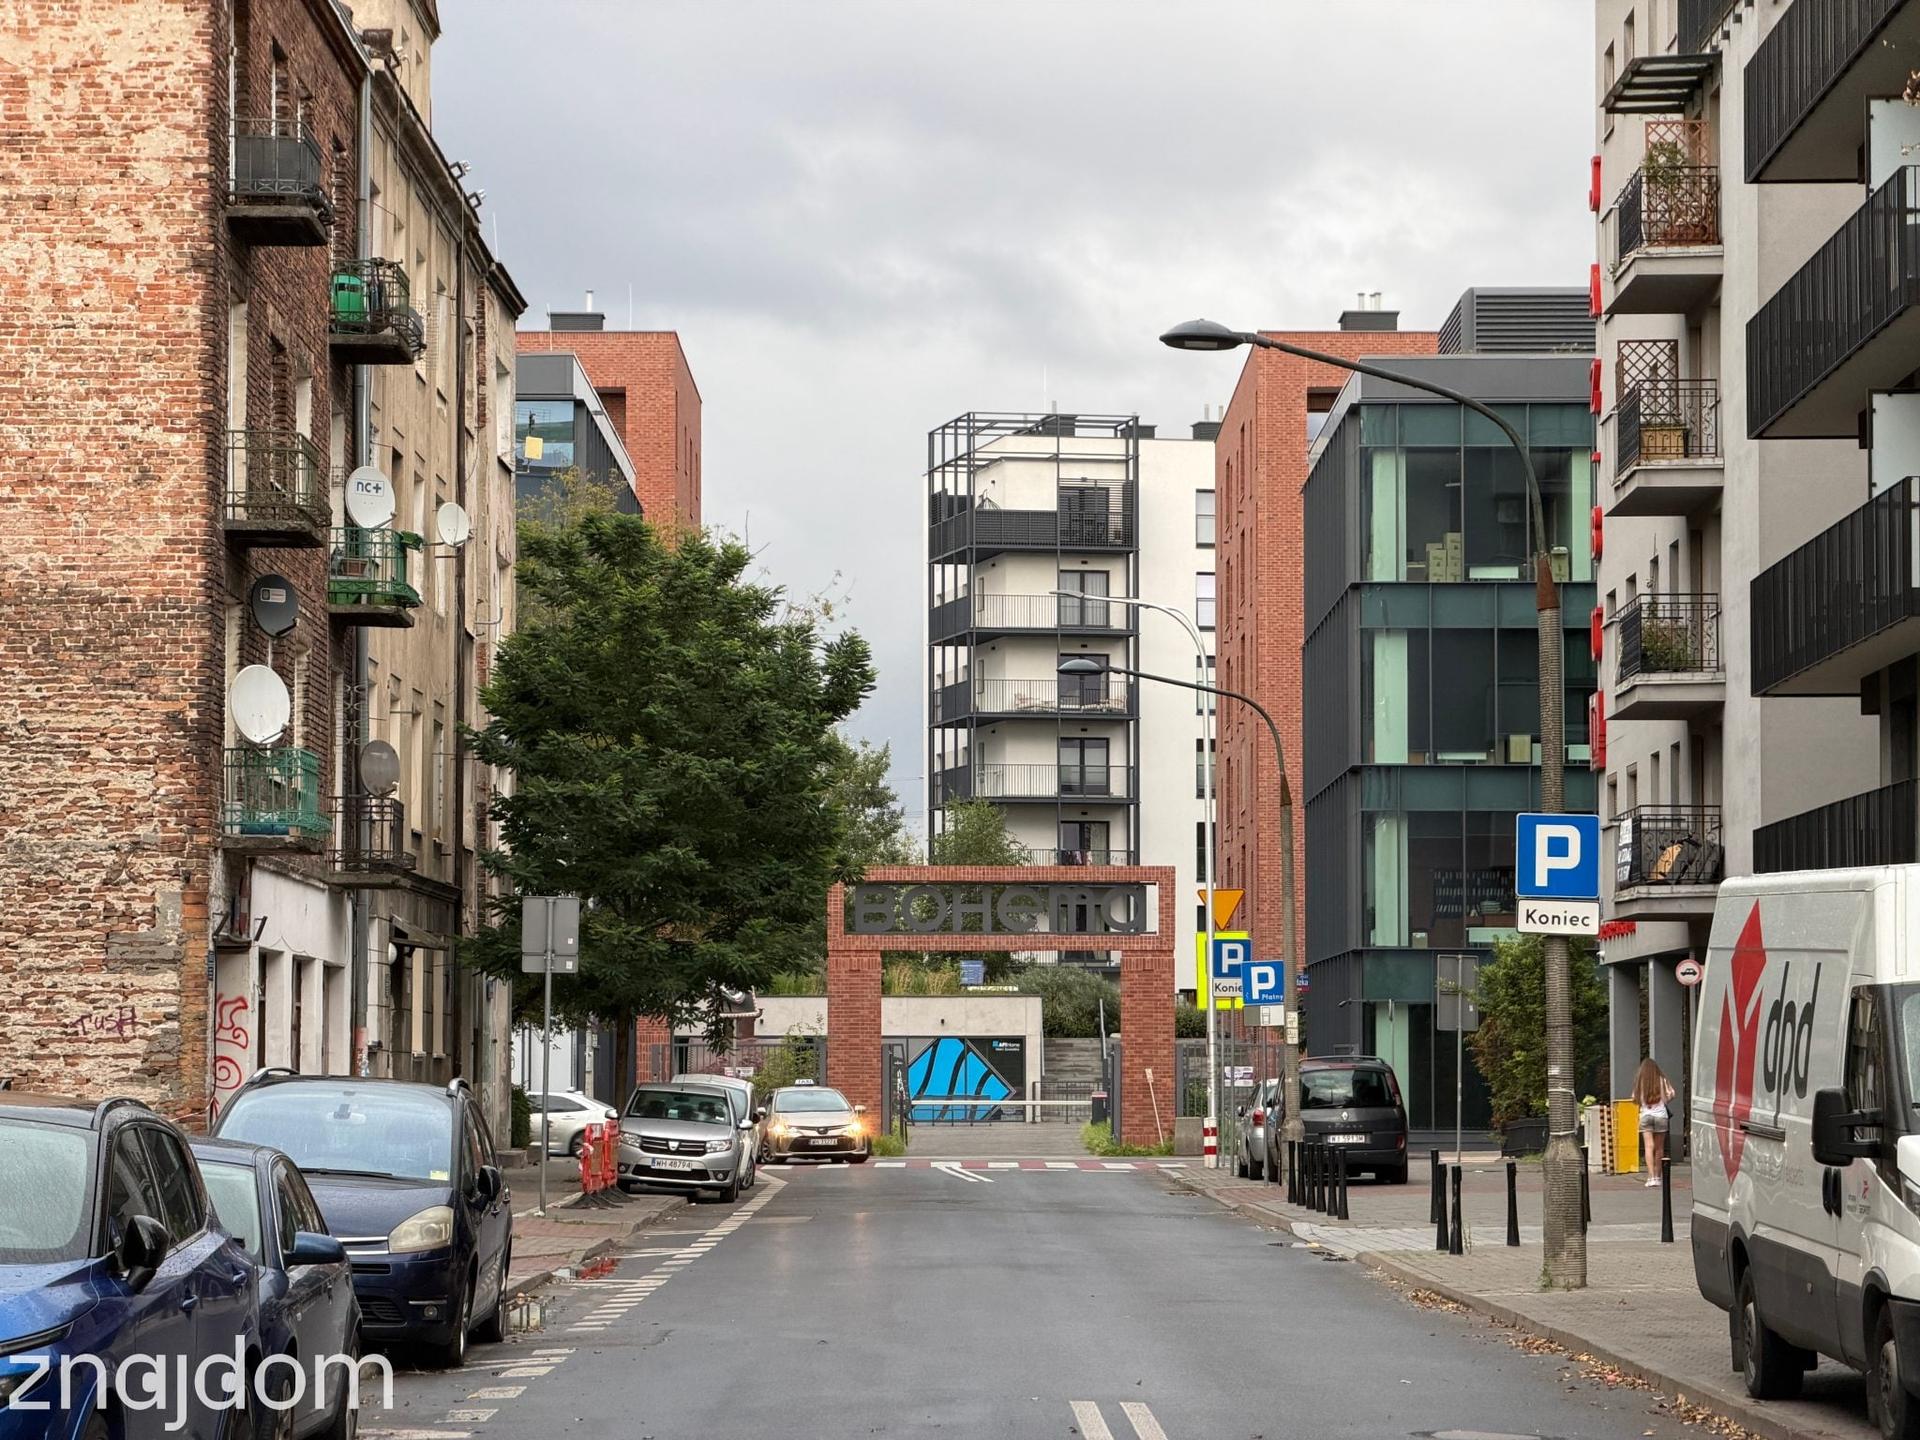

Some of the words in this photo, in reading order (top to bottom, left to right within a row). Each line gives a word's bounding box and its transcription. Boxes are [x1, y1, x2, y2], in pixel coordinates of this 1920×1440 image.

[356, 480, 382, 494] nc+
[1535, 824, 1581, 887] P
[1525, 908, 1590, 927] Koniec
[1222, 943, 1244, 973] P
[1214, 982, 1243, 993] Konie
[1251, 966, 1276, 1000] P
[1763, 960, 1822, 1129] dpd
